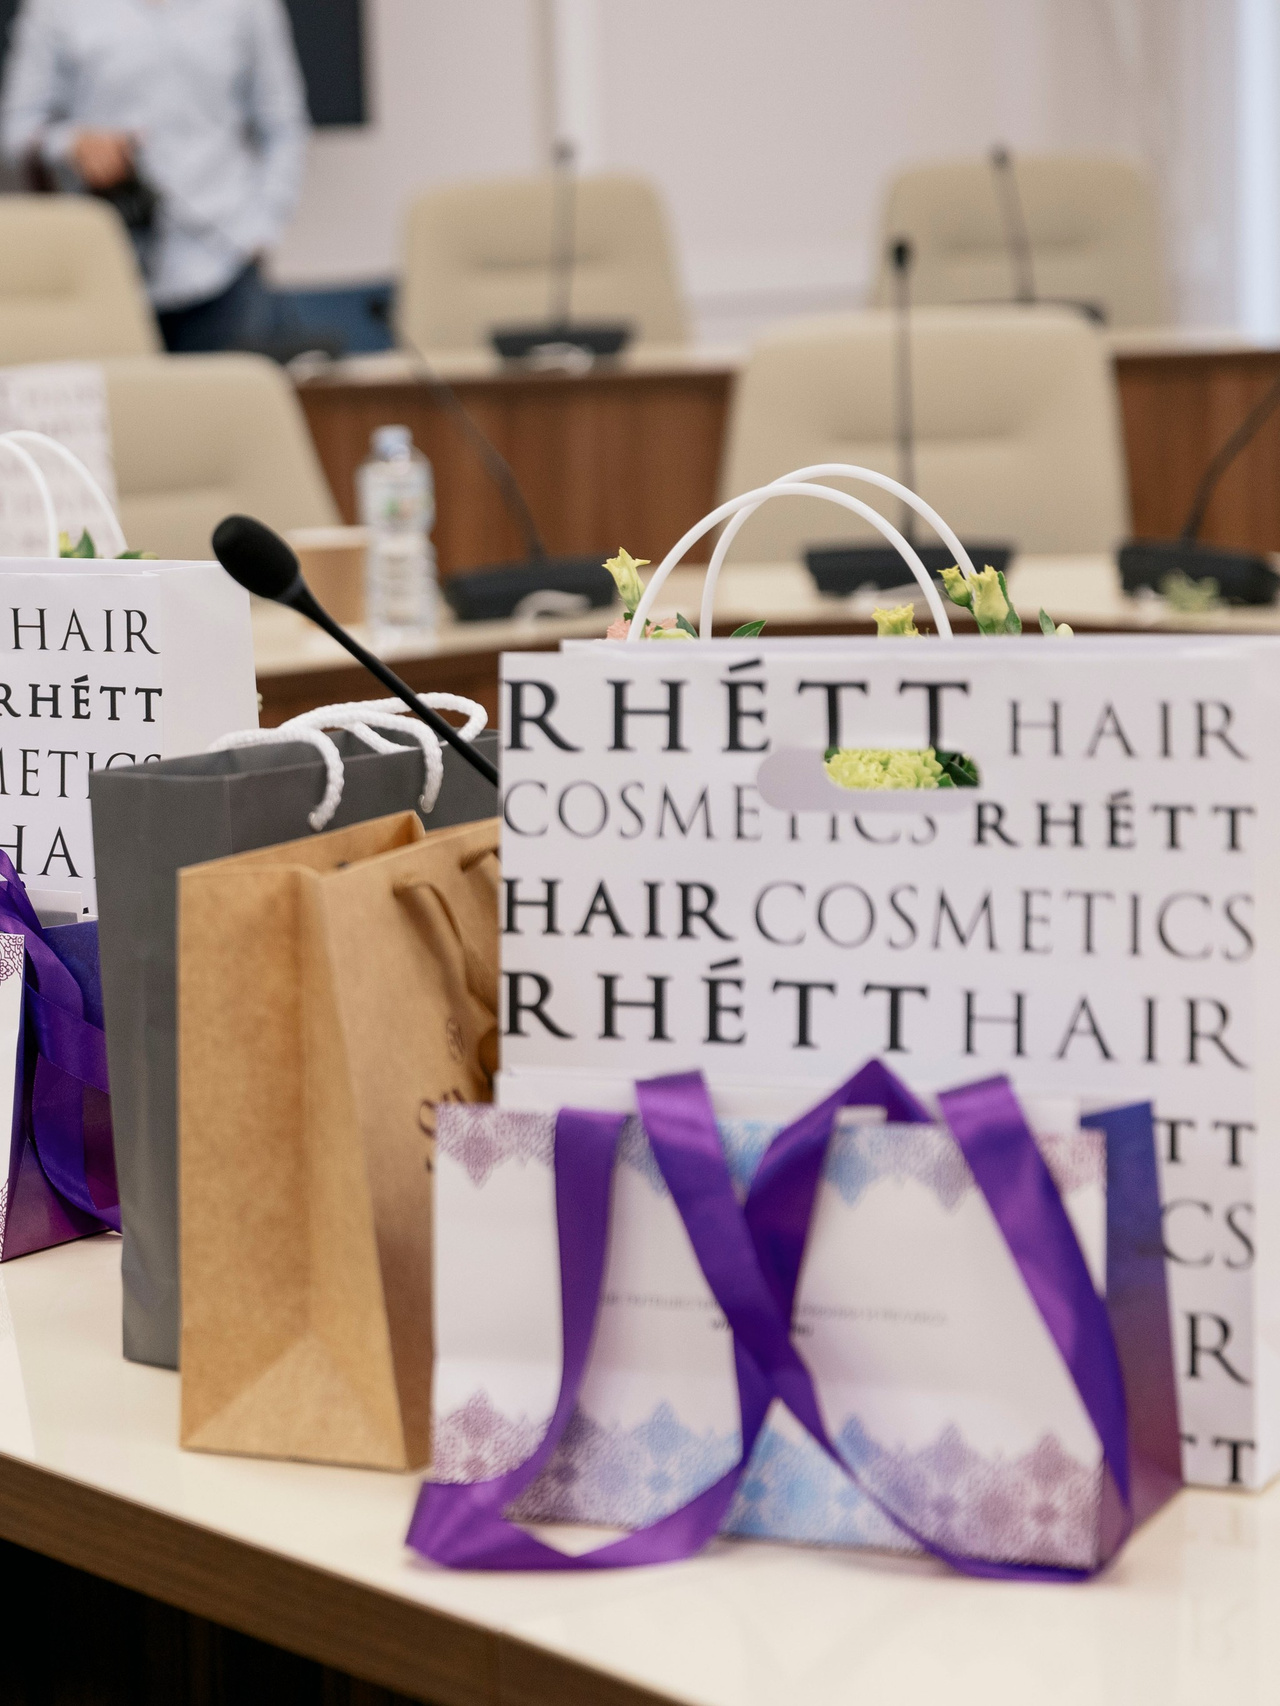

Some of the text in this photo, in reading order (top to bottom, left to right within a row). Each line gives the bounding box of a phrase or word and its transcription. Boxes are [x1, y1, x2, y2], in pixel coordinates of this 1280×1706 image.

[10, 606, 161, 655] HAIR
[501, 659, 1249, 762] RHÉTT HAIR
[974, 790, 1257, 853] RHÉTT
[502, 877, 1257, 961] HAIR COSMETICS
[502, 957, 1248, 1070] RHÉTT HAIR
